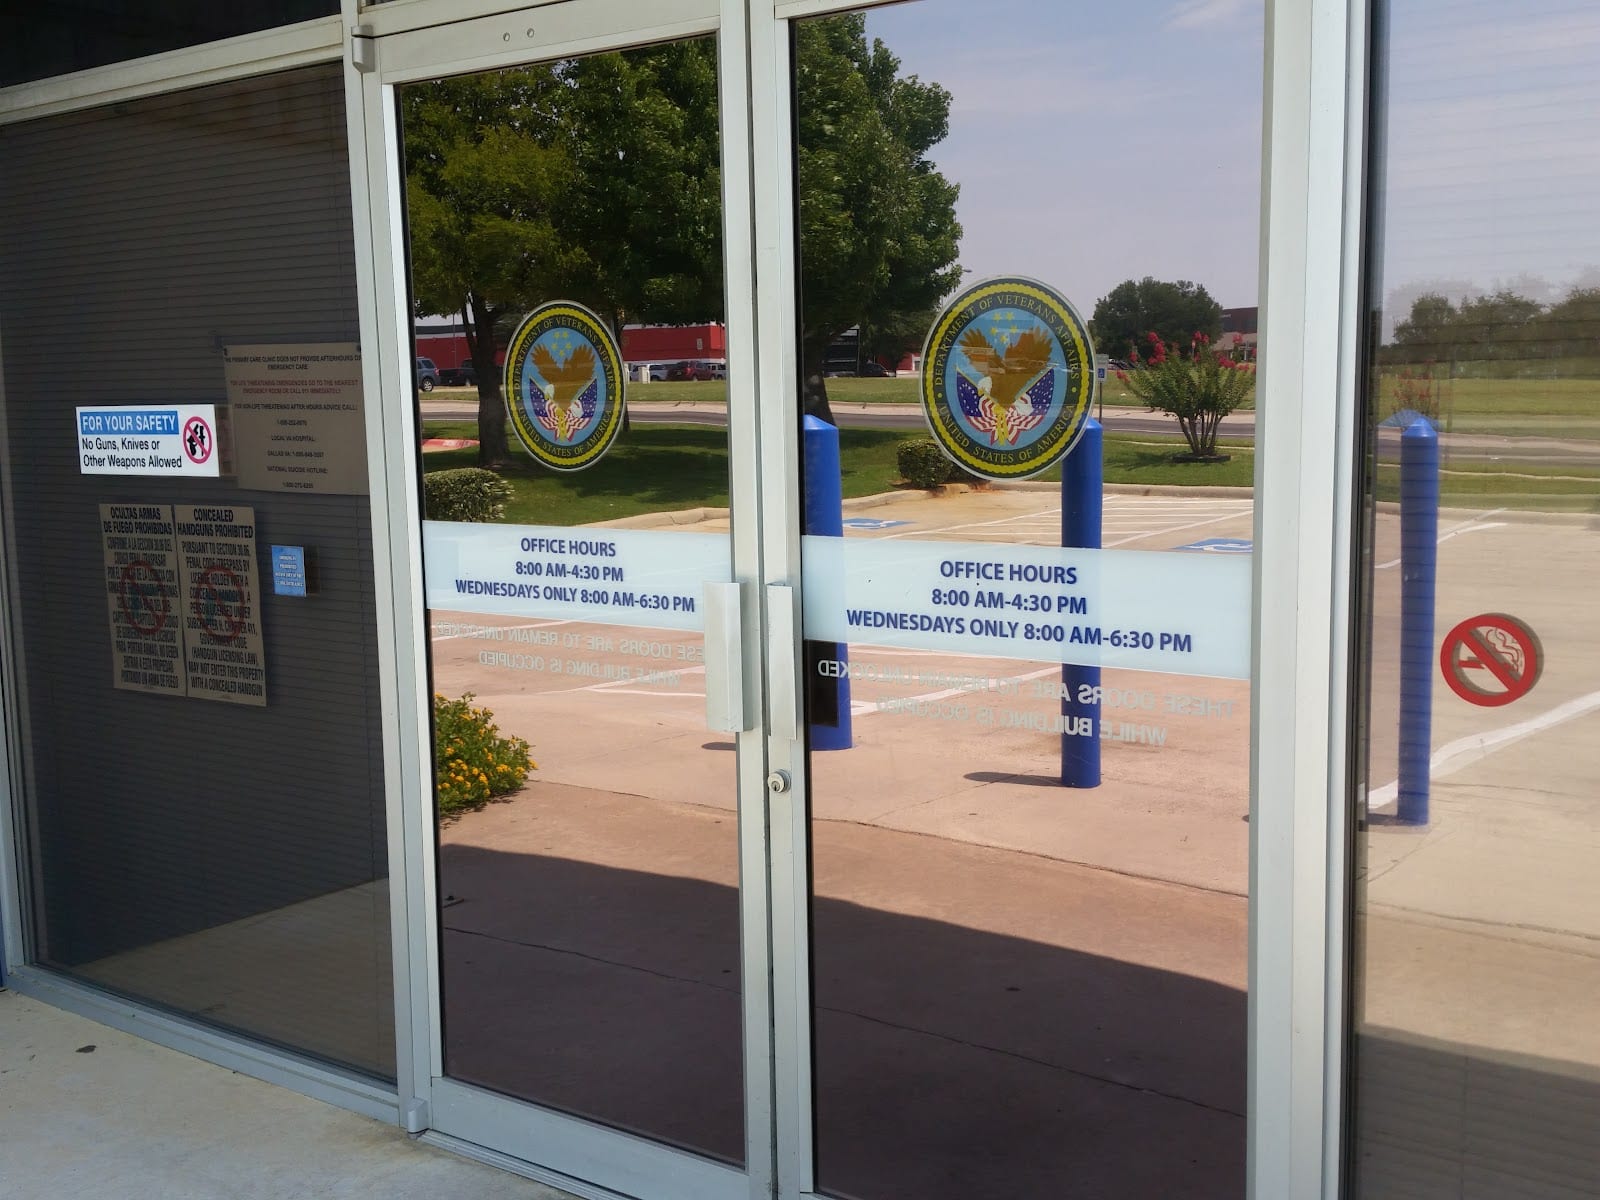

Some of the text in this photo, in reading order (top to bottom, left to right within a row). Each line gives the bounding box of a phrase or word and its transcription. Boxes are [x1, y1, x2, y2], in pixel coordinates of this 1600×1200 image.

[936, 294, 1080, 386] DEPARTMENT OF VETERANS AFFAIRS
[514, 318, 615, 390] DEPARTMENT OF VETERANS AFFAIRS
[82, 414, 176, 430] FOR YOUR SAFETY
[518, 406, 614, 457] UNITED STATES OF AMERICA
[940, 404, 1074, 464] UNITED STATES OF AMERICA
[82, 438, 160, 452] No Guns, Knives or
[84, 454, 182, 470] Other Weapons Allowed
[110, 507, 160, 520] OCULTAS ARMAS
[194, 508, 234, 522] CONCEALED
[104, 521, 172, 534] DE FUEGO PROHIBIDAS
[178, 522, 254, 538] HANDGUNS PROHIBITED
[182, 541, 208, 554] PURSUANT
[209, 542, 216, 554] TO
[216, 542, 236, 556] SECTION
[521, 538, 616, 557] OFFICE HOURS
[186, 556, 202, 568] PENAL
[516, 561, 624, 582] 8:00 AM-4:30 PM
[244, 576, 248, 587] A
[940, 560, 1078, 585] OFFICE HOURS
[246, 592, 250, 602] A
[456, 580, 695, 612] WEDNESDAYS ONLY 8:00 AM-6:30 PM
[932, 588, 1088, 615] 8:00 AM-4:30 PM
[846, 609, 1192, 653] WEDNESDAYS ONLY 8:00 AM-6:30 PM
[188, 661, 200, 673] MAY
[200, 662, 210, 674] NOT
[210, 664, 226, 677] ENTER
[227, 666, 238, 678] THIS
[239, 666, 264, 680] PROPERTY
[190, 676, 204, 689] WITH
[204, 676, 208, 690] A
[208, 678, 236, 693] CONCEALED
[237, 681, 262, 696] HANDGUN
